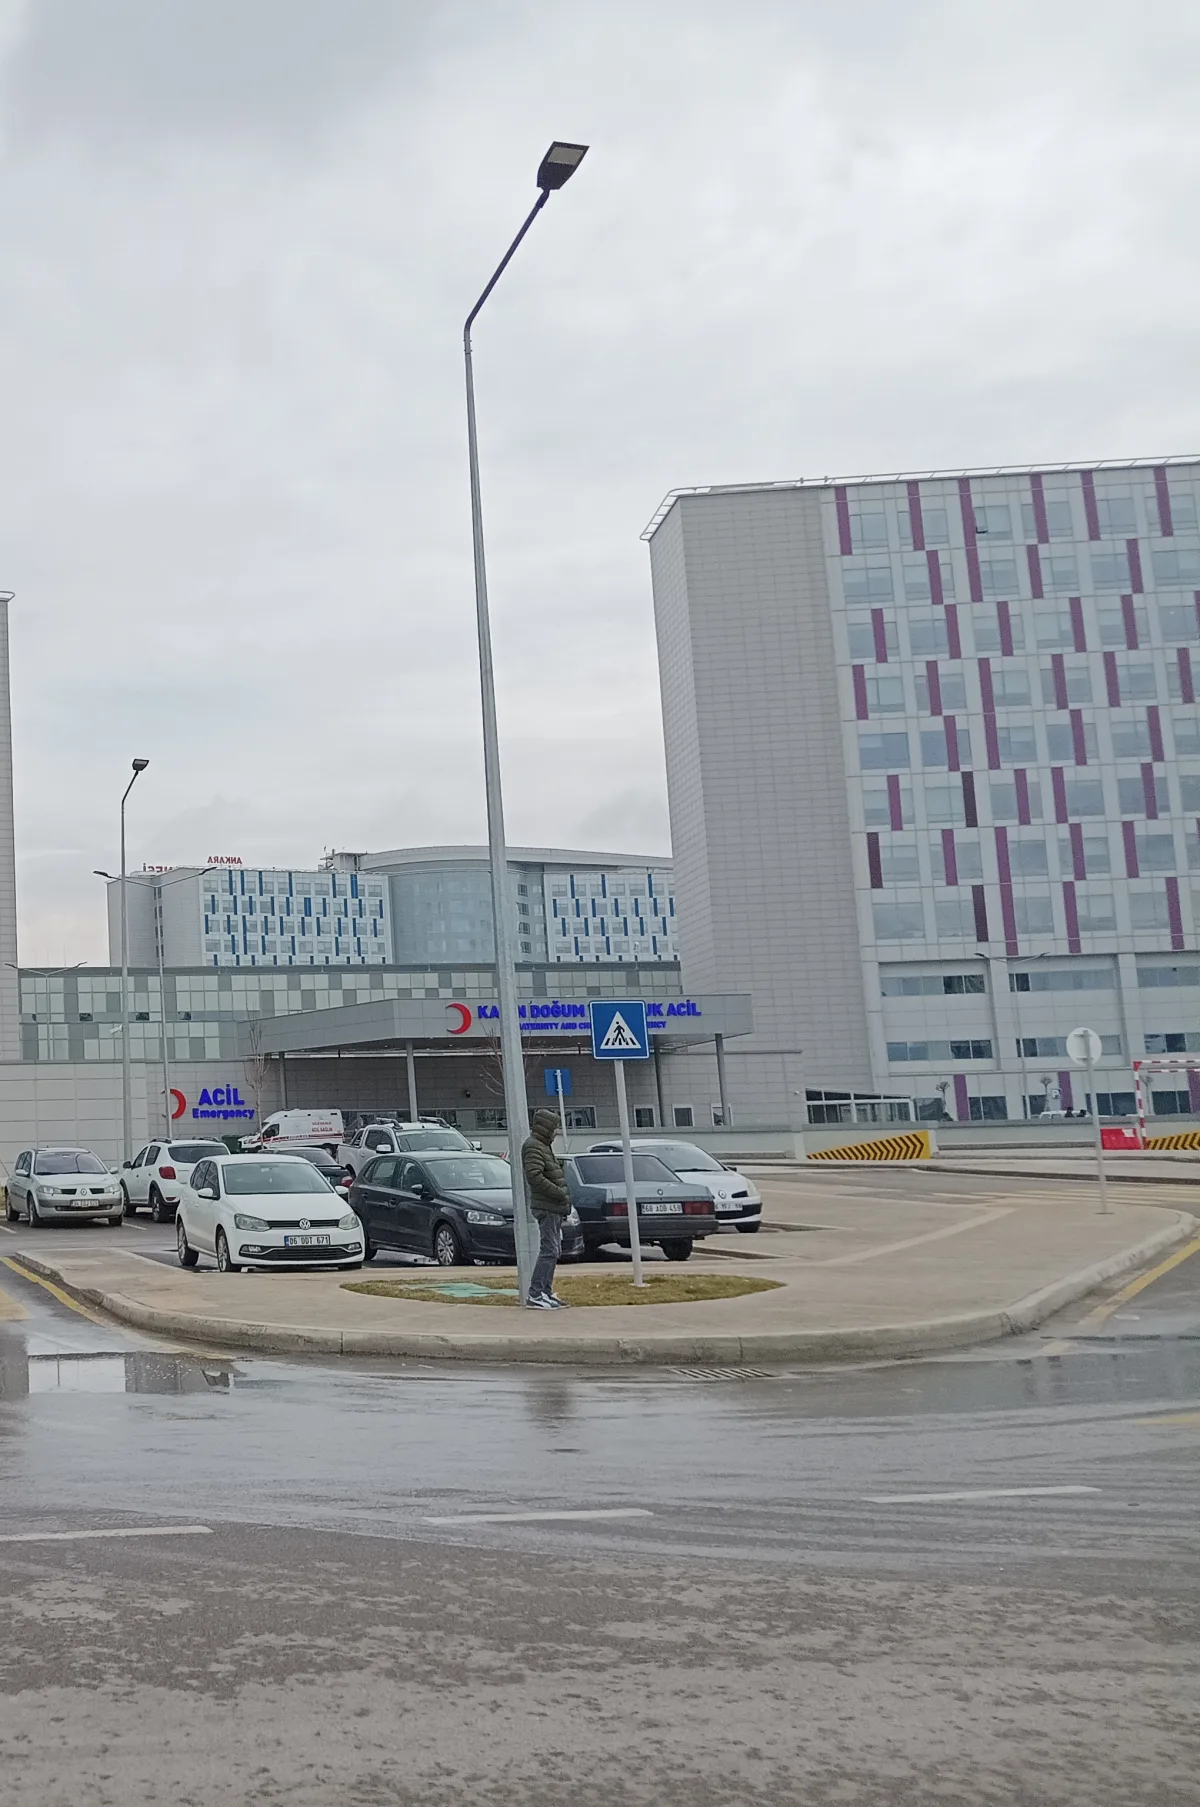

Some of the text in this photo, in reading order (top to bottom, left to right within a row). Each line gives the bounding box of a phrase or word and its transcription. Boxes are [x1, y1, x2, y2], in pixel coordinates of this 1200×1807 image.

[477, 1005, 527, 1019] KAN
[530, 1000, 586, 1019] DOĞUM
[666, 999, 702, 1017] ACİL
[198, 1083, 246, 1106] ACİL
[192, 1108, 255, 1121] Emergency
[290, 1237, 297, 1245] 06
[317, 1236, 328, 1244] 671
